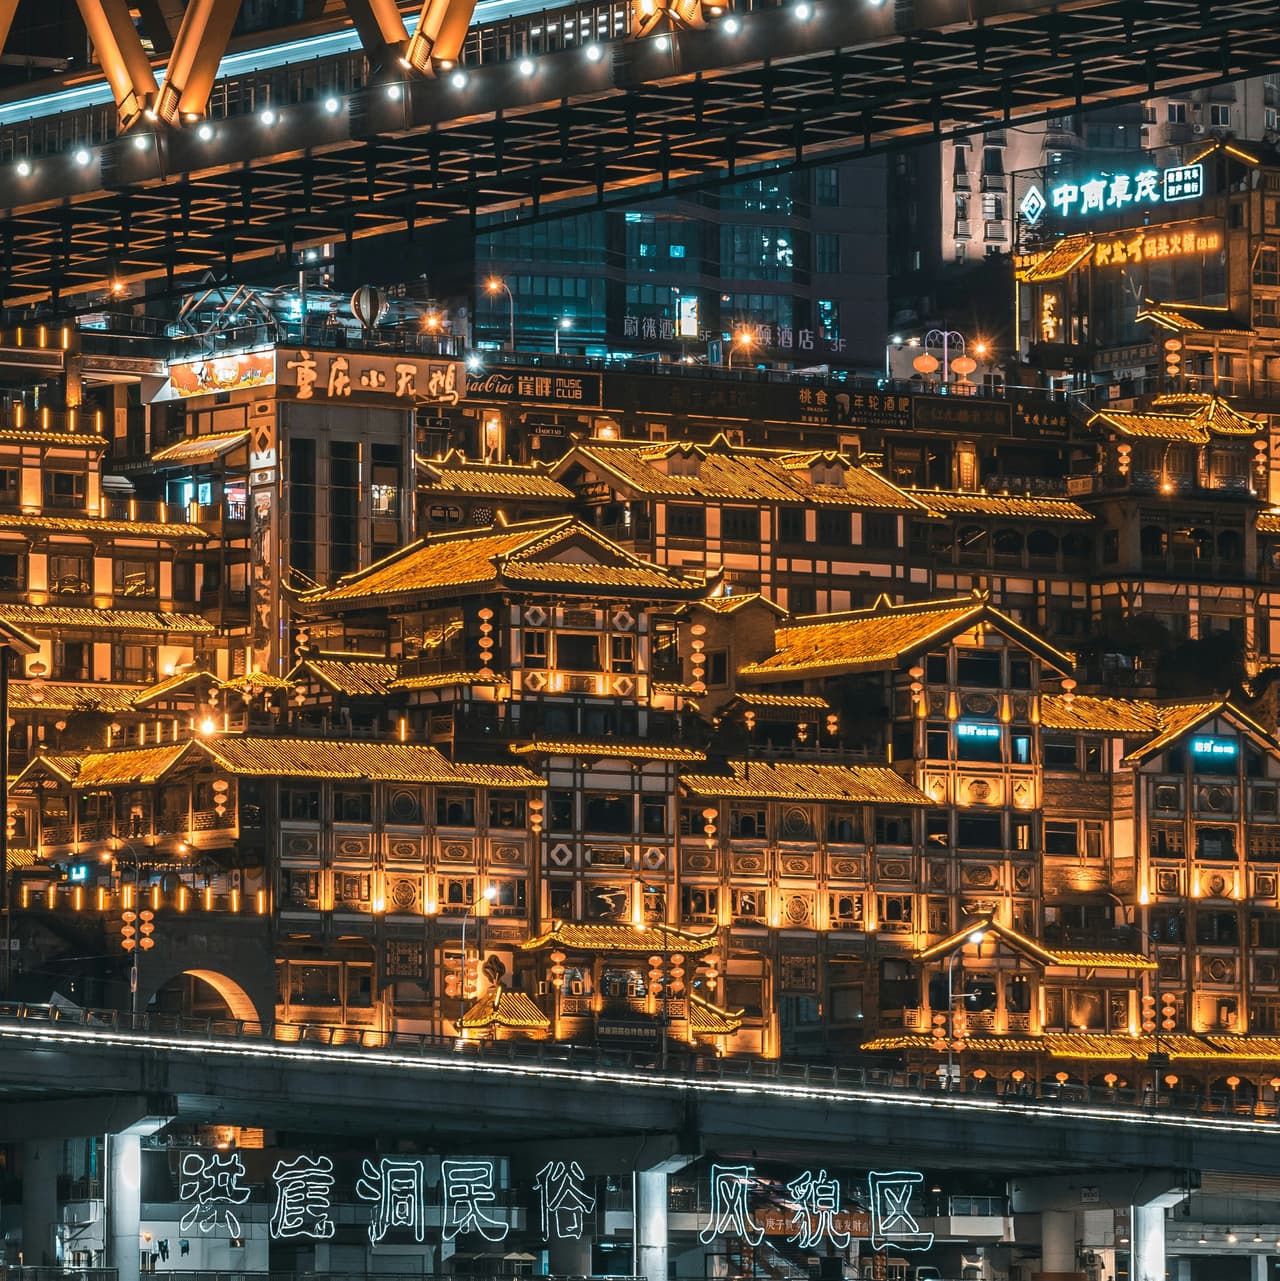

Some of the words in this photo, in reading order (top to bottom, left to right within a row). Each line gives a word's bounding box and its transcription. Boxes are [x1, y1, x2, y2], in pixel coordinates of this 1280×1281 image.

[286, 351, 458, 406] 重庆小天鹅
[467, 373, 514, 394] iaoCiao
[555, 378, 582, 389] MUSIC
[555, 388, 582, 399] CLUB
[179, 1154, 596, 1245] 洪崖洞民俗
[700, 1164, 934, 1250] 风貌区
